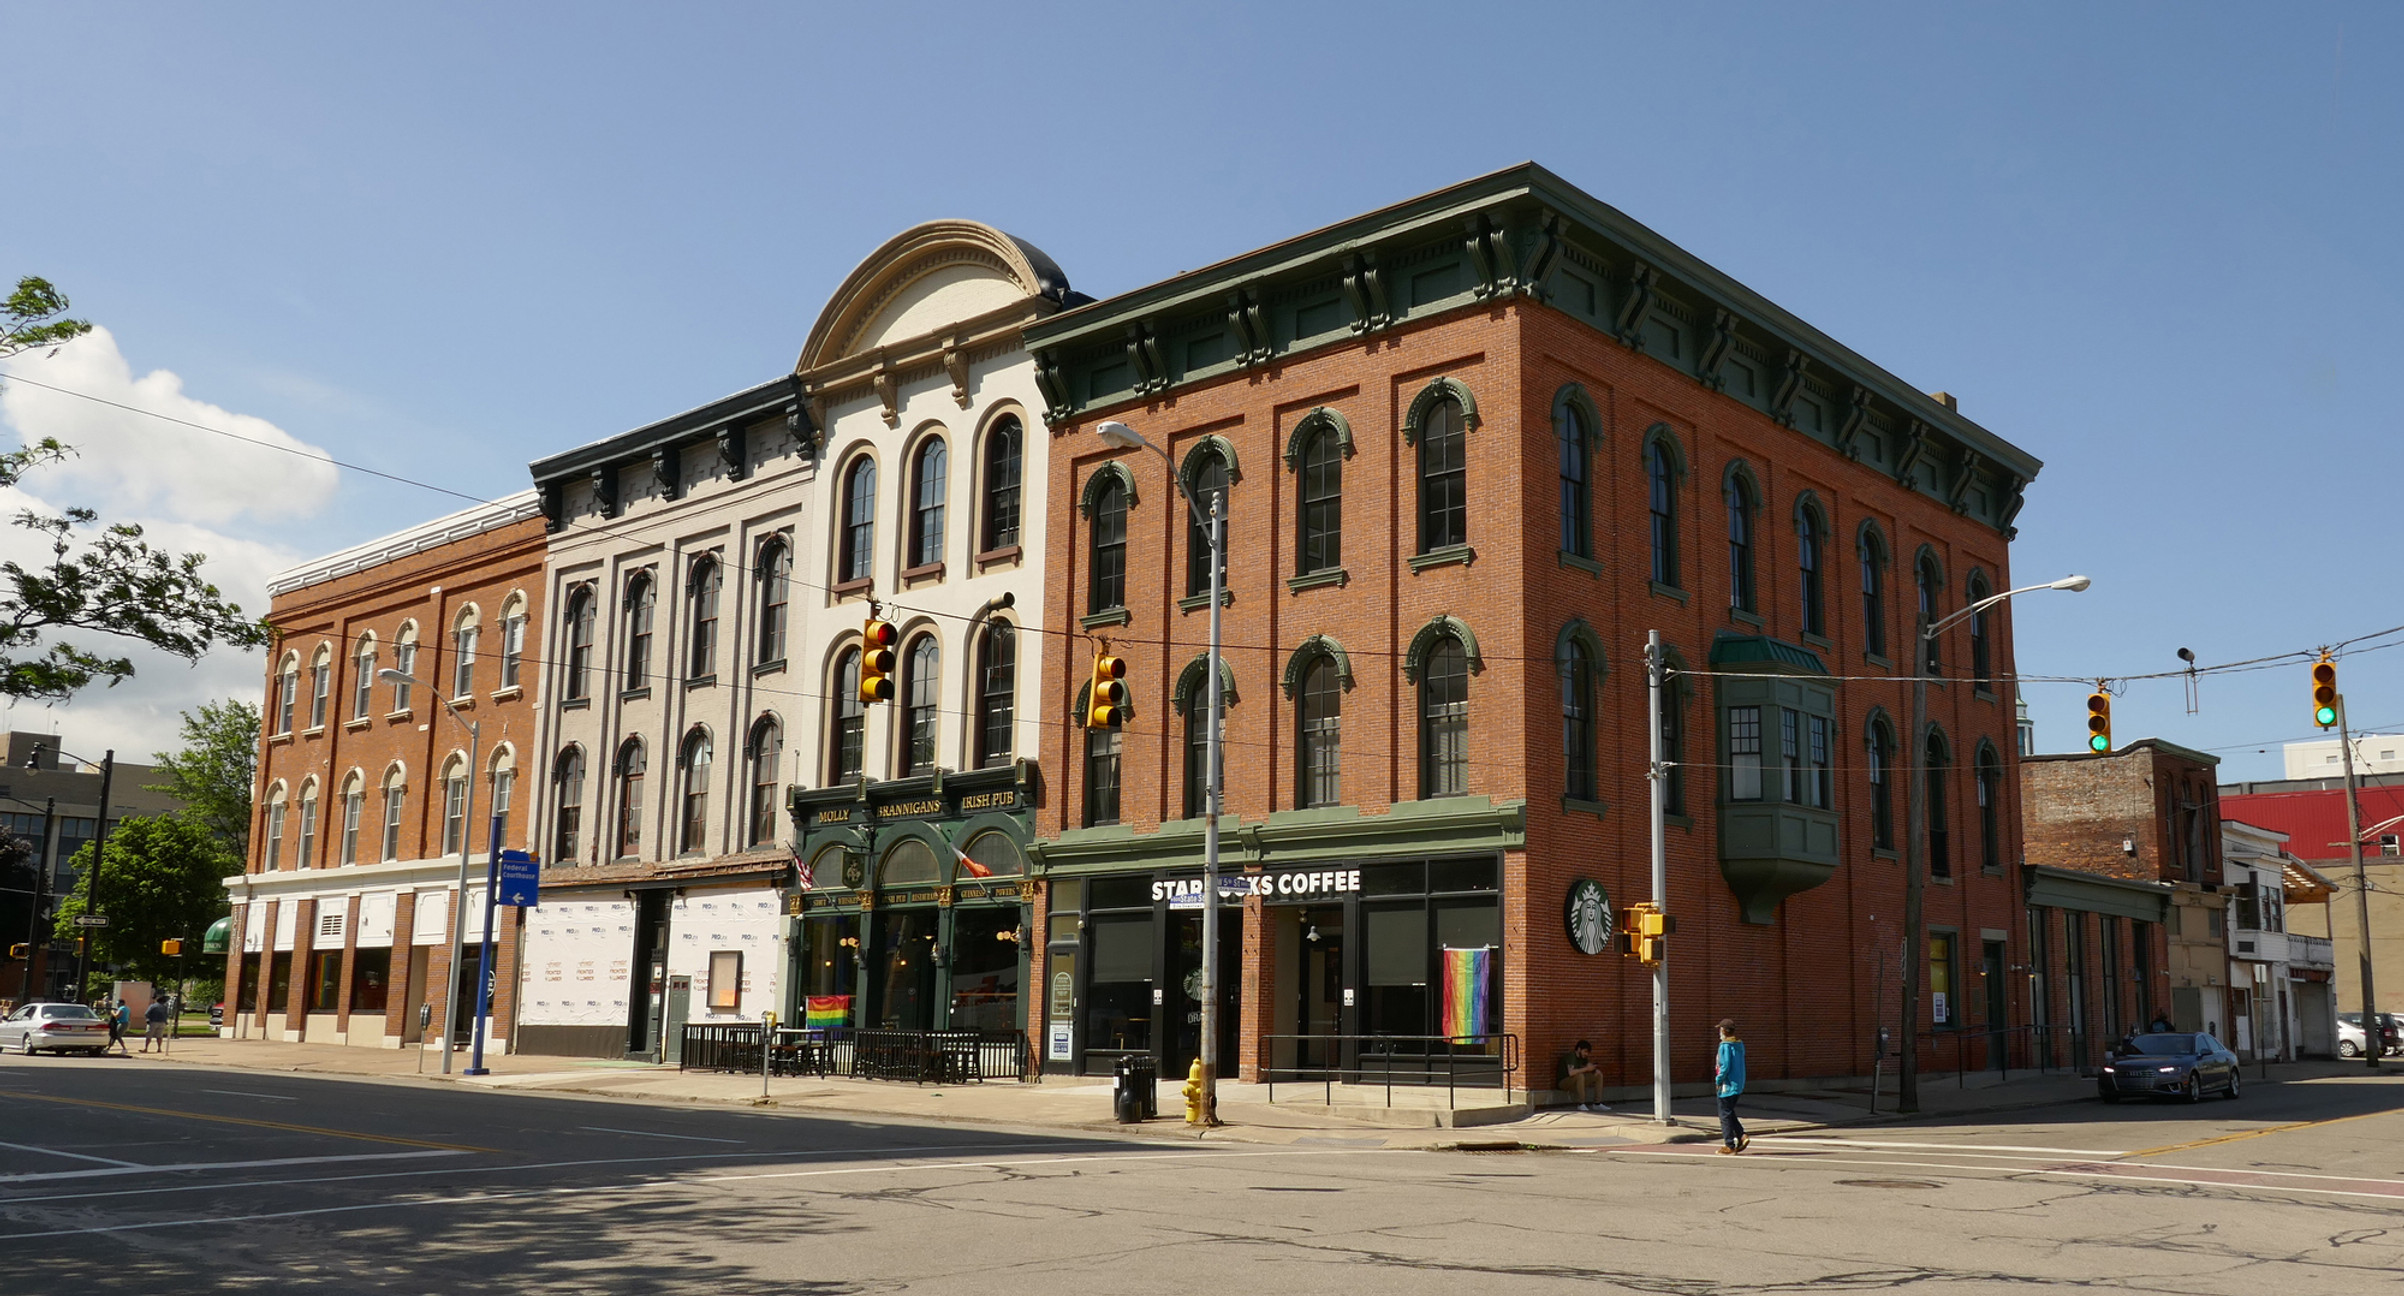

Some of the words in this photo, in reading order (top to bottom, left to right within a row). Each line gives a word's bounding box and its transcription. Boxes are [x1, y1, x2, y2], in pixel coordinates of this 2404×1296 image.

[818, 809, 850, 823] MOLLY
[962, 794, 991, 809] IRISH
[992, 791, 1014, 806] PUB
[503, 864, 528, 872] Federal
[503, 871, 535, 880] Courthouse
[1151, 875, 1274, 901] STARKS
[1278, 870, 1361, 895] COFFEE
